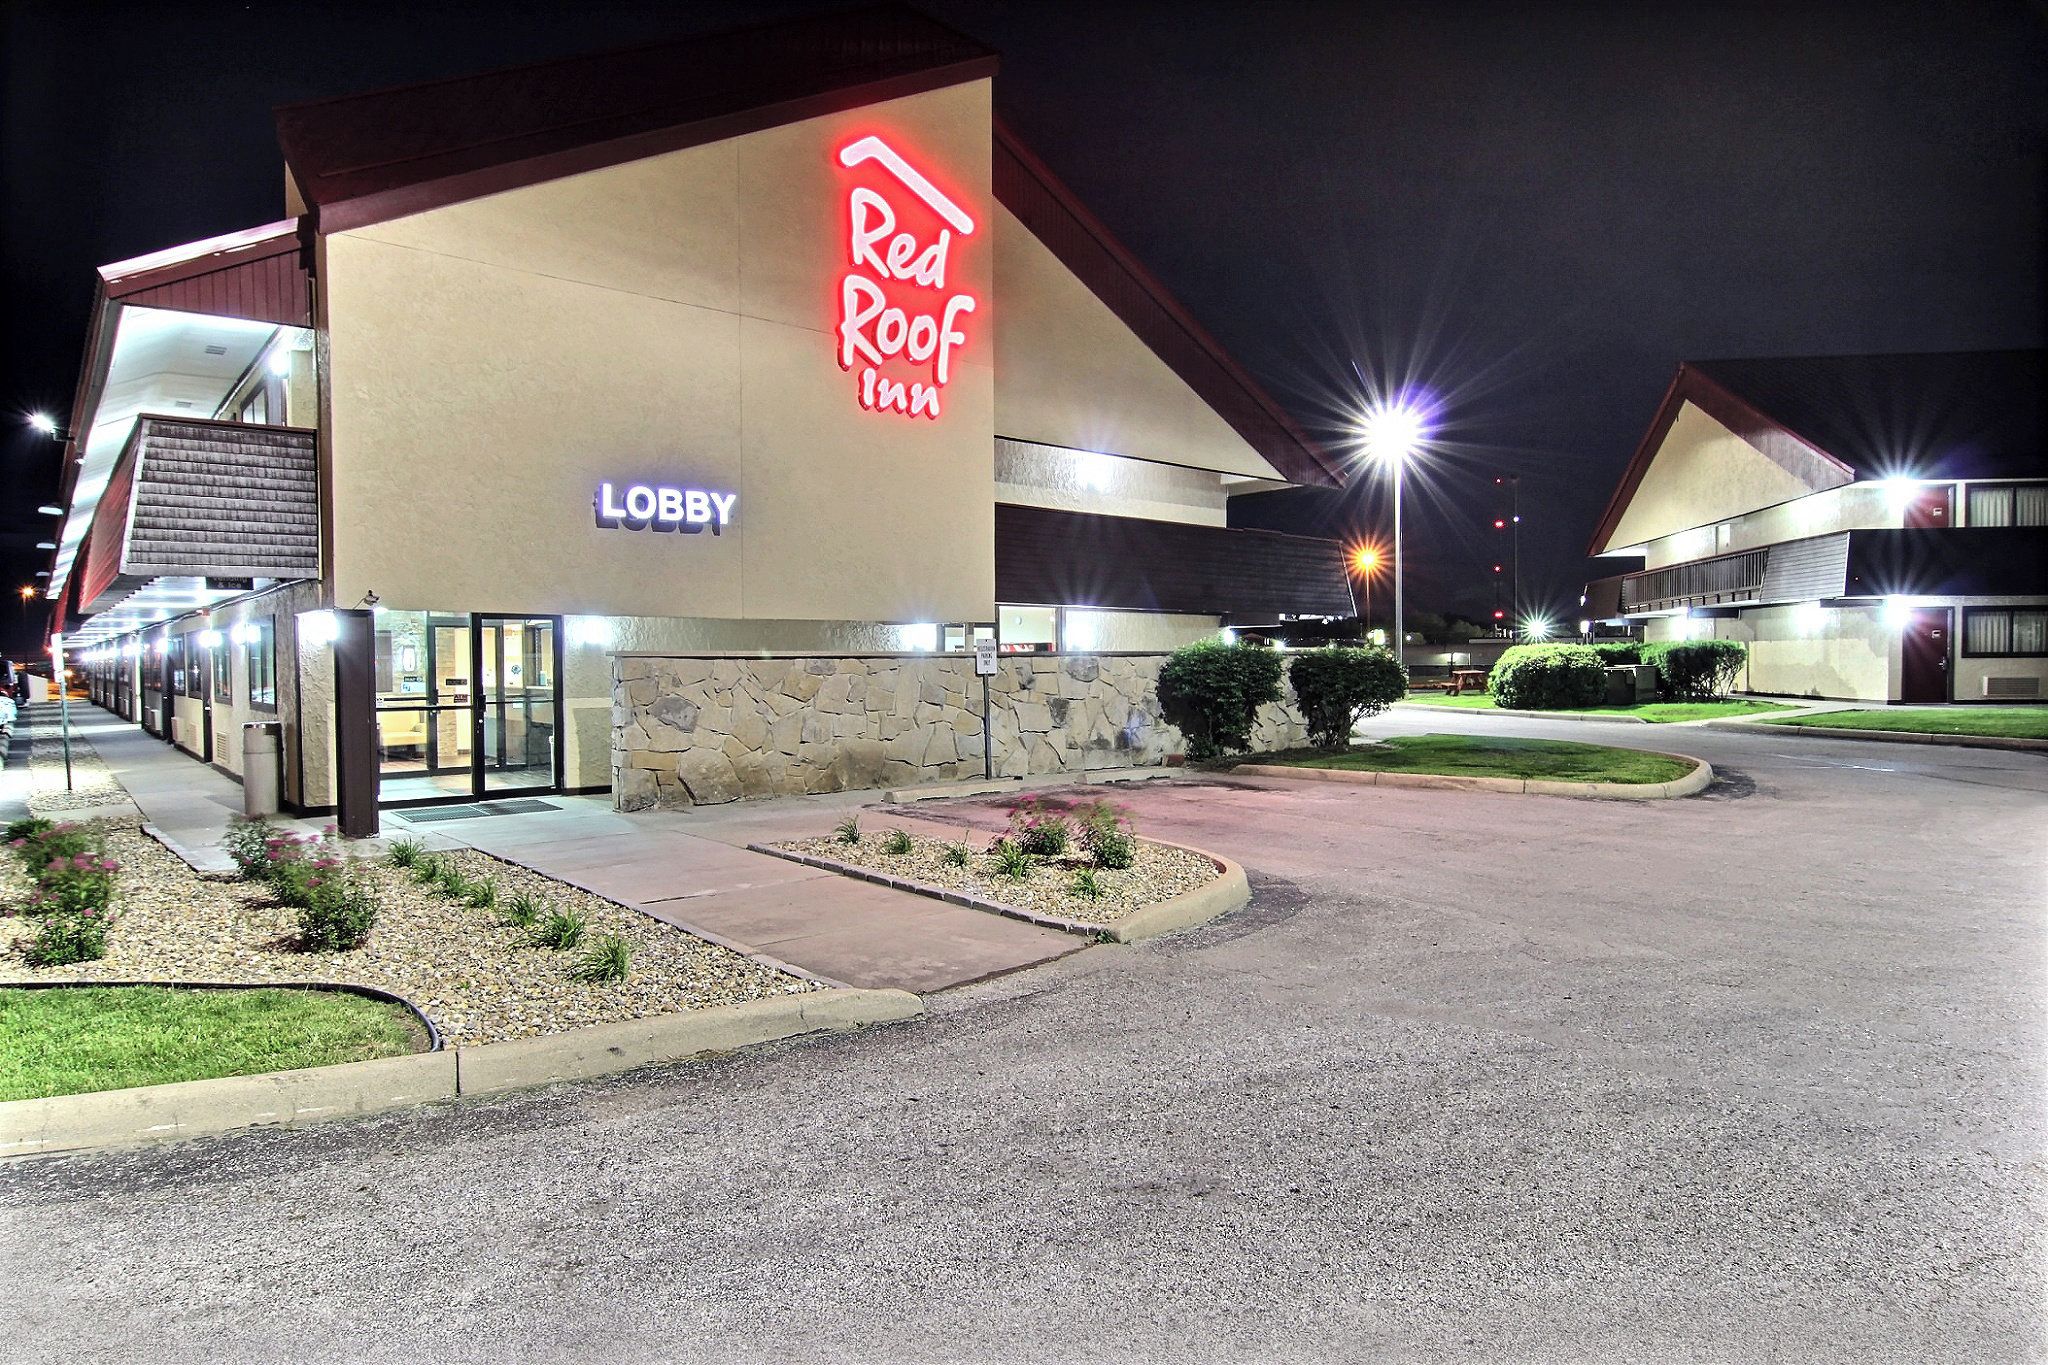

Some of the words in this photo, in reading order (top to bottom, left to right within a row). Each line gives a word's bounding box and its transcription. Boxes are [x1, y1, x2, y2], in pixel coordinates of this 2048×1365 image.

[850, 187, 950, 289] Red
[840, 275, 976, 384] Roof
[862, 367, 941, 417] Inn
[601, 482, 737, 526] LOBBY
